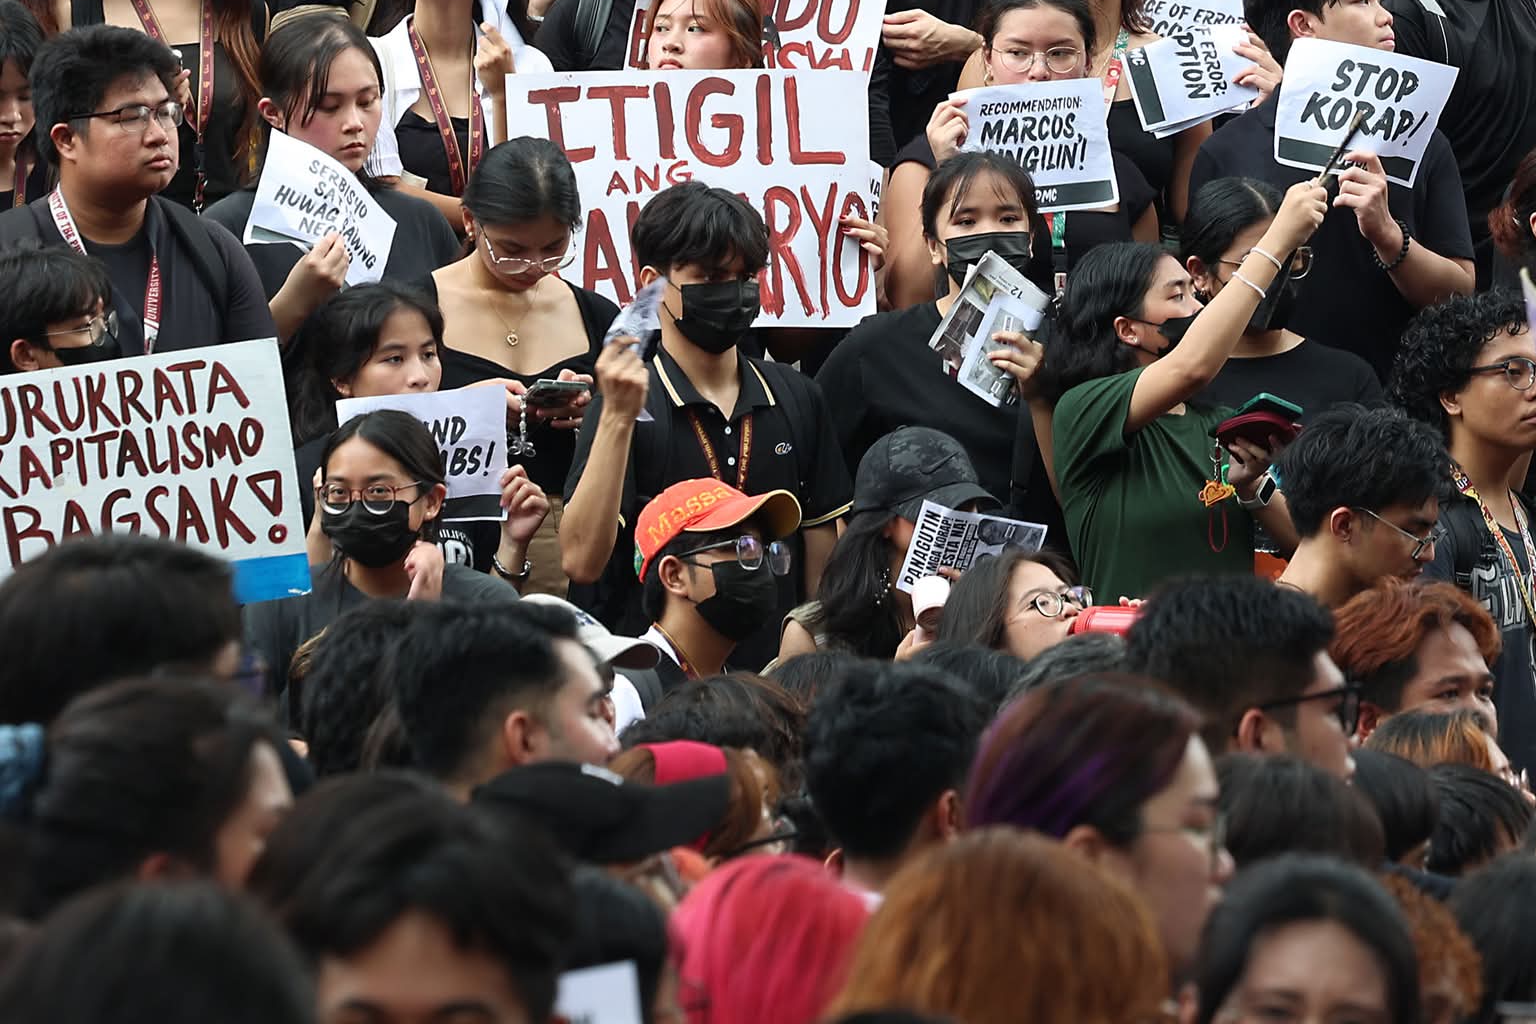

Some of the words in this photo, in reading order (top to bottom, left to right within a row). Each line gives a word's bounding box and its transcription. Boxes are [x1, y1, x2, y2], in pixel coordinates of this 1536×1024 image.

[1169, 5, 1193, 22] OF
[1331, 58, 1420, 104] STOP
[527, 73, 847, 168] ITIGIL
[979, 95, 1083, 118] RECOMMENDATION:
[1299, 91, 1430, 147] KORAP!
[980, 112, 1084, 146] MARCOS,
[605, 159, 695, 197] ANG
[273, 183, 341, 223] HUWAG
[146, 265, 159, 321] UNIVERSITY
[647, 486, 733, 547] Massa
[934, 515, 955, 551] KORAP!
[903, 509, 942, 587] PANAGUTIN
